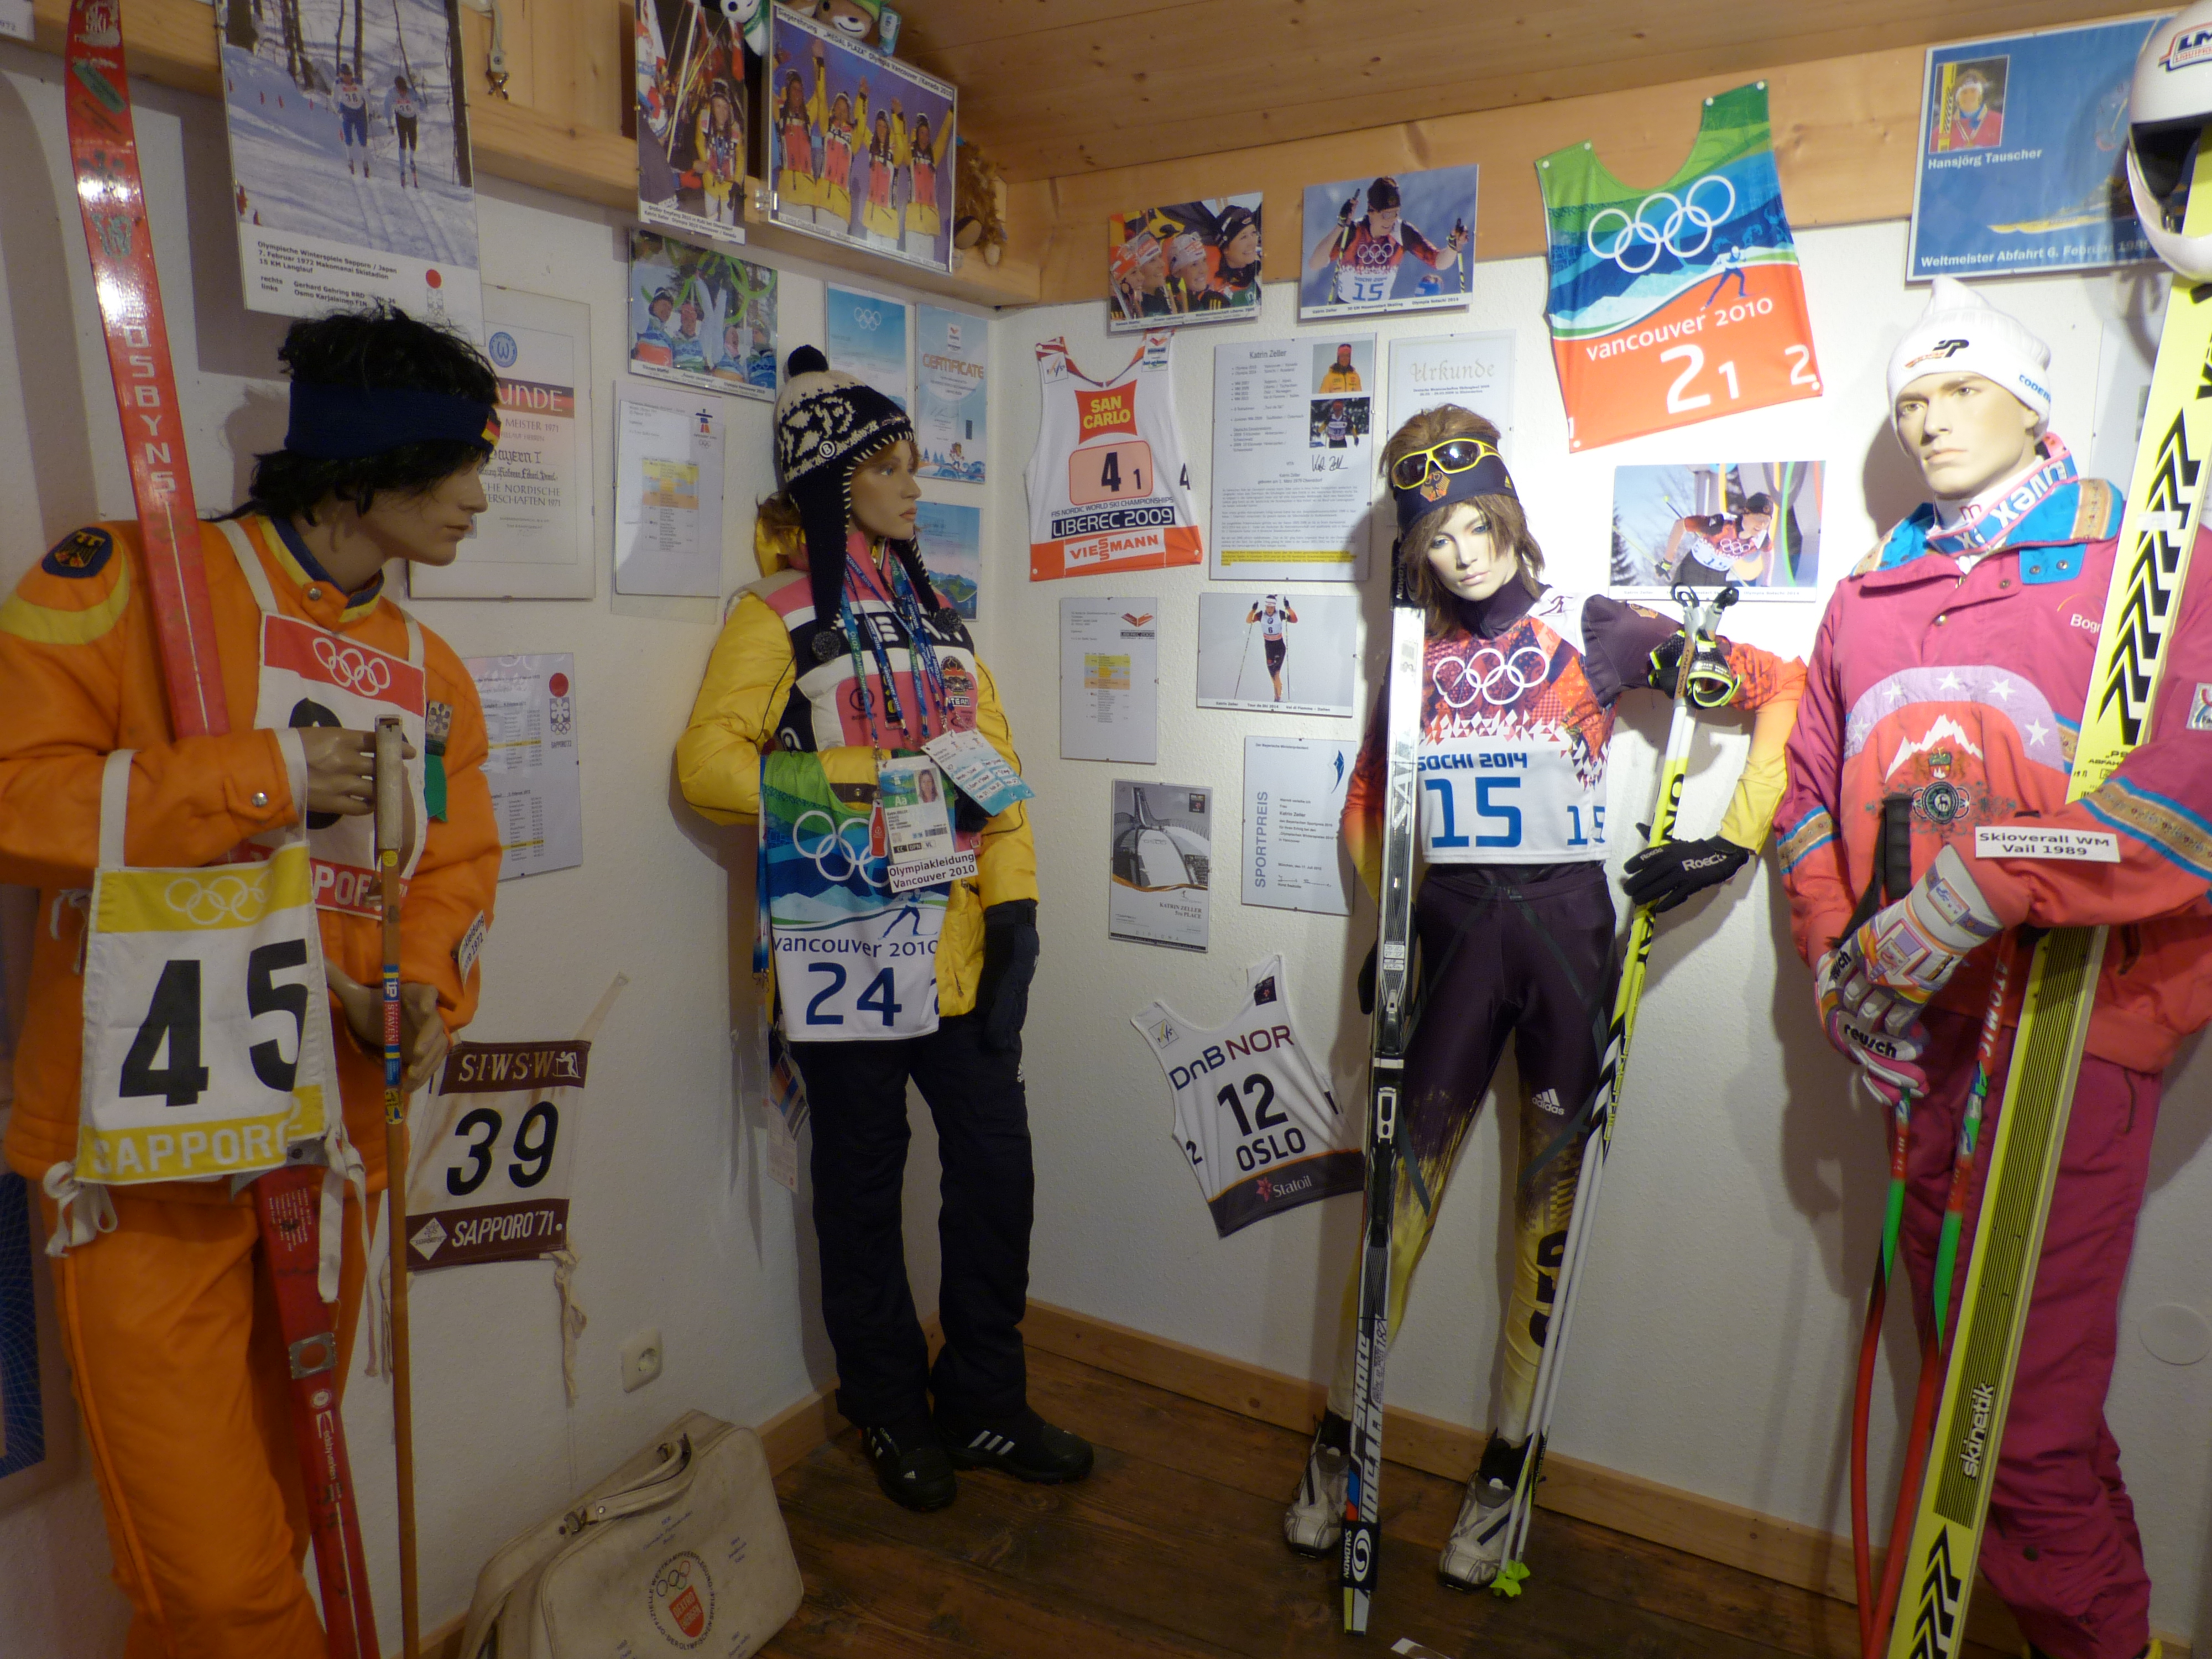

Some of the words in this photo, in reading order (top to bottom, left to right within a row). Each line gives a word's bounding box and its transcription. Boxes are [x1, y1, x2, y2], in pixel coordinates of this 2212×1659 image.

[778, 8, 817, 34] Siegerehrung
[1929, 154, 1981, 169] Hansjörg
[1985, 148, 2042, 164] Tauscher
[258, 241, 299, 255] Olympische
[300, 249, 343, 263] Winterspiele
[345, 258, 371, 270] Sapporo
[378, 265, 397, 274] Japan
[268, 252, 294, 262] Februar
[297, 257, 314, 265] 1972
[356, 268, 389, 280] Skistadion
[1922, 252, 1994, 268] Weltmeister
[1997, 247, 2044, 262] Abfahrt
[2047, 246, 2059, 258] 6.
[2063, 242, 2112, 257] Februar
[261, 275, 283, 285] rechts
[283, 263, 314, 274] Langlauf
[261, 283, 278, 292] links
[294, 280, 321, 291] Gerhard
[324, 285, 349, 298] Gehring
[294, 289, 314, 299] Osmo
[316, 293, 354, 305] Karjalainen
[1352, 282, 1384, 301] 15
[1586, 312, 1707, 362] vancouver
[1716, 297, 1773, 327] 2010
[922, 353, 984, 379] CERTIFICATE
[1269, 349, 1287, 358] Zeller
[1785, 344, 1817, 386] 2
[1411, 358, 1495, 383] Urkunde
[1660, 343, 1712, 414] 2
[1718, 361, 1740, 399] 1
[1090, 395, 1122, 414] SAN
[505, 419, 541, 431] MEISTER
[545, 423, 559, 433] 1971
[1083, 408, 1131, 429] CARLO
[1100, 451, 1121, 492] 4
[1133, 468, 1141, 491] 1
[1180, 462, 1191, 491] 4
[505, 484, 561, 497] NORDISCHE
[548, 498, 561, 507] 1971
[1990, 459, 2069, 530] uvex
[1061, 505, 1084, 517] NORDIC
[1085, 502, 1108, 512] WORLD
[1109, 500, 1120, 509] SKI
[1121, 496, 1174, 508] CHAMPIONSHIPS
[1051, 511, 1121, 537] LIBEREC
[1124, 508, 1173, 527] 2009
[1069, 534, 1159, 561] VIESSMANN
[1417, 753, 1472, 772] SOCHI
[1479, 752, 1528, 769] 2014
[895, 795, 907, 807] Aa
[1424, 776, 1522, 848] 15
[1255, 791, 1268, 888] SPORTPREIS
[1979, 832, 2070, 844] Skioverall
[2077, 836, 2110, 847] WM
[2002, 843, 2036, 854] Vail
[2042, 844, 2088, 856] 1989
[889, 853, 975, 878] Olympiakleidung
[893, 871, 947, 889] Vancouver
[949, 864, 975, 878] 2010
[1160, 902, 1180, 910] KATRIN
[1180, 905, 1202, 914] ZELLER
[1183, 911, 1202, 920] PLACE
[774, 936, 882, 958] vancouver
[889, 940, 938, 958] 2010
[806, 962, 902, 1027] 24
[1979, 959, 2008, 1058] ATOMIC
[119, 938, 309, 1107] 45
[387, 1003, 395, 1042] STAVEN
[1844, 1022, 1897, 1058] reusch
[1217, 1073, 1289, 1137] 12
[1532, 1097, 1565, 1115] adidas
[446, 1101, 559, 1196] 39
[1186, 1140, 1203, 1165] 2
[1235, 1127, 1306, 1172] OSLO
[1273, 1175, 1312, 1198] Statoil
[1961, 1383, 1994, 1479] skinetik
[1343, 1529, 1352, 1579] SALOMON
